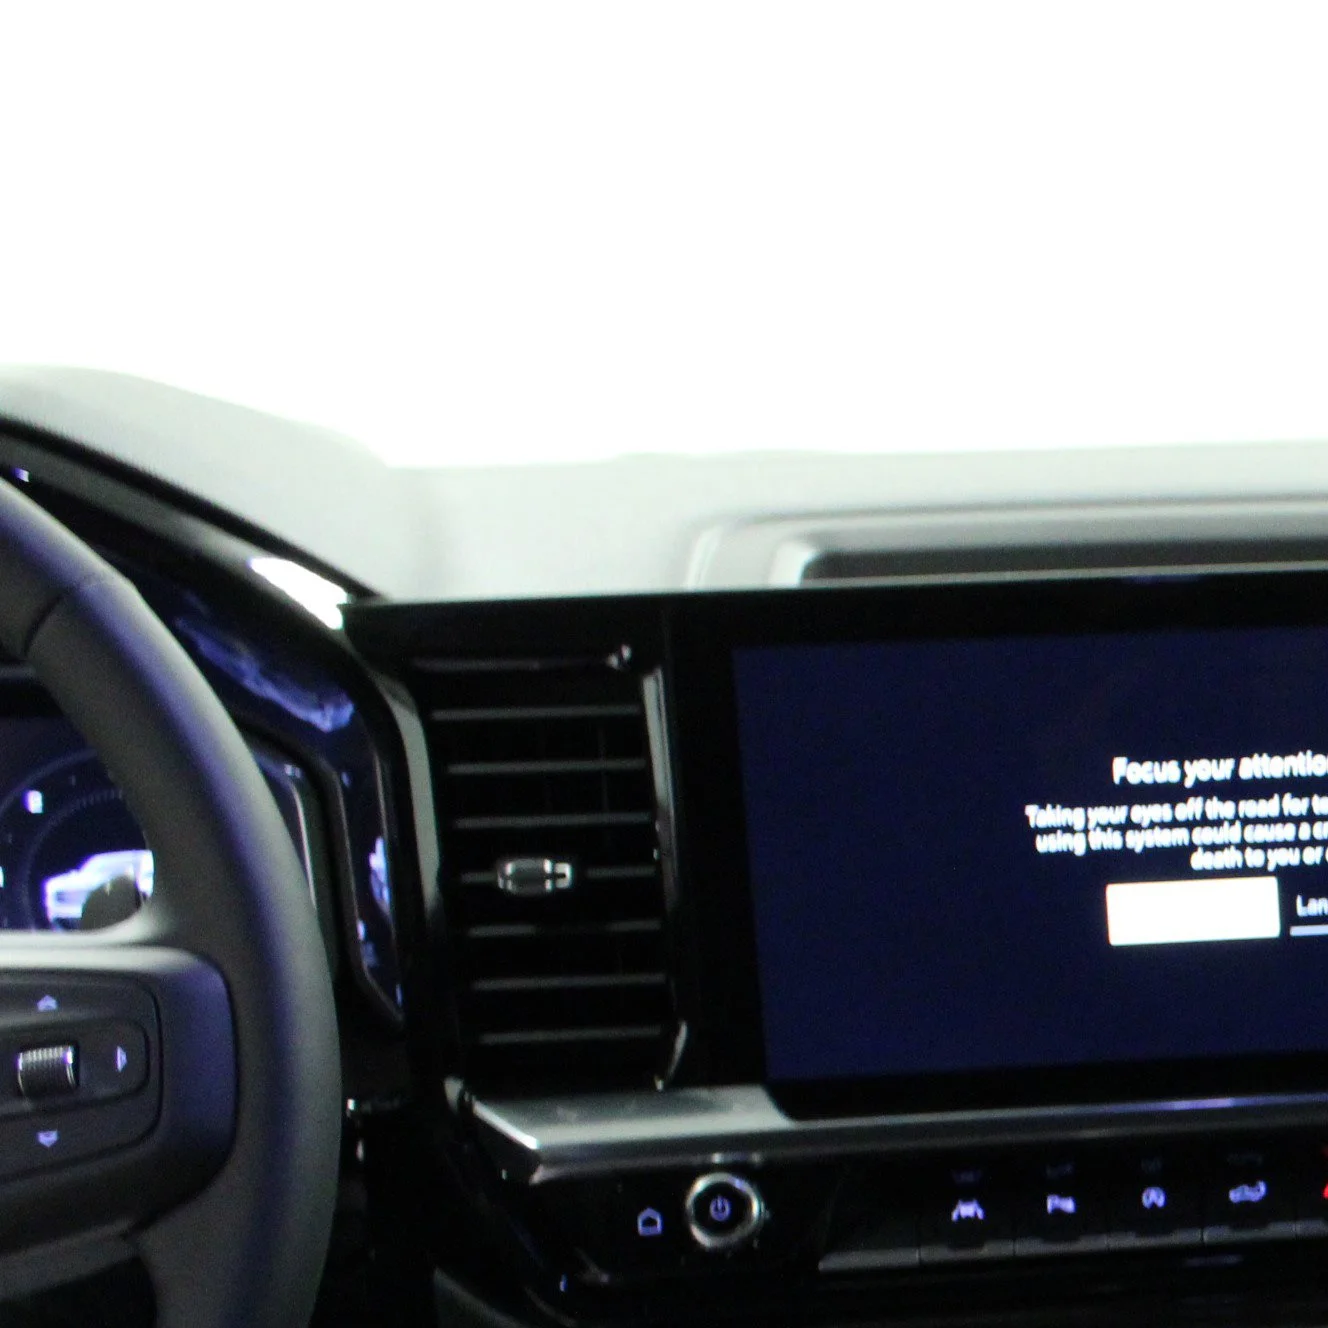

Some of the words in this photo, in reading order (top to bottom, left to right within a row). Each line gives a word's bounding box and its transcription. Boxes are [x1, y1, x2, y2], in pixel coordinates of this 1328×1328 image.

[1112, 757, 1181, 784] Focus
[1184, 758, 1235, 788] your
[1025, 803, 1086, 830] Taking
[1087, 805, 1128, 830] your
[1130, 803, 1172, 828] eyes
[1175, 796, 1203, 820] off
[1205, 796, 1236, 819] the
[1238, 793, 1280, 818] road
[1282, 793, 1310, 816] for
[1035, 829, 1086, 856] using
[1088, 827, 1123, 850] this
[1125, 826, 1190, 853] system
[1192, 820, 1242, 845] could
[1244, 823, 1296, 843] cause
[1298, 822, 1311, 841] a
[1190, 845, 1243, 870] death
[1244, 846, 1265, 868] to
[1267, 847, 1300, 872] you
[1302, 846, 1323, 865] or
